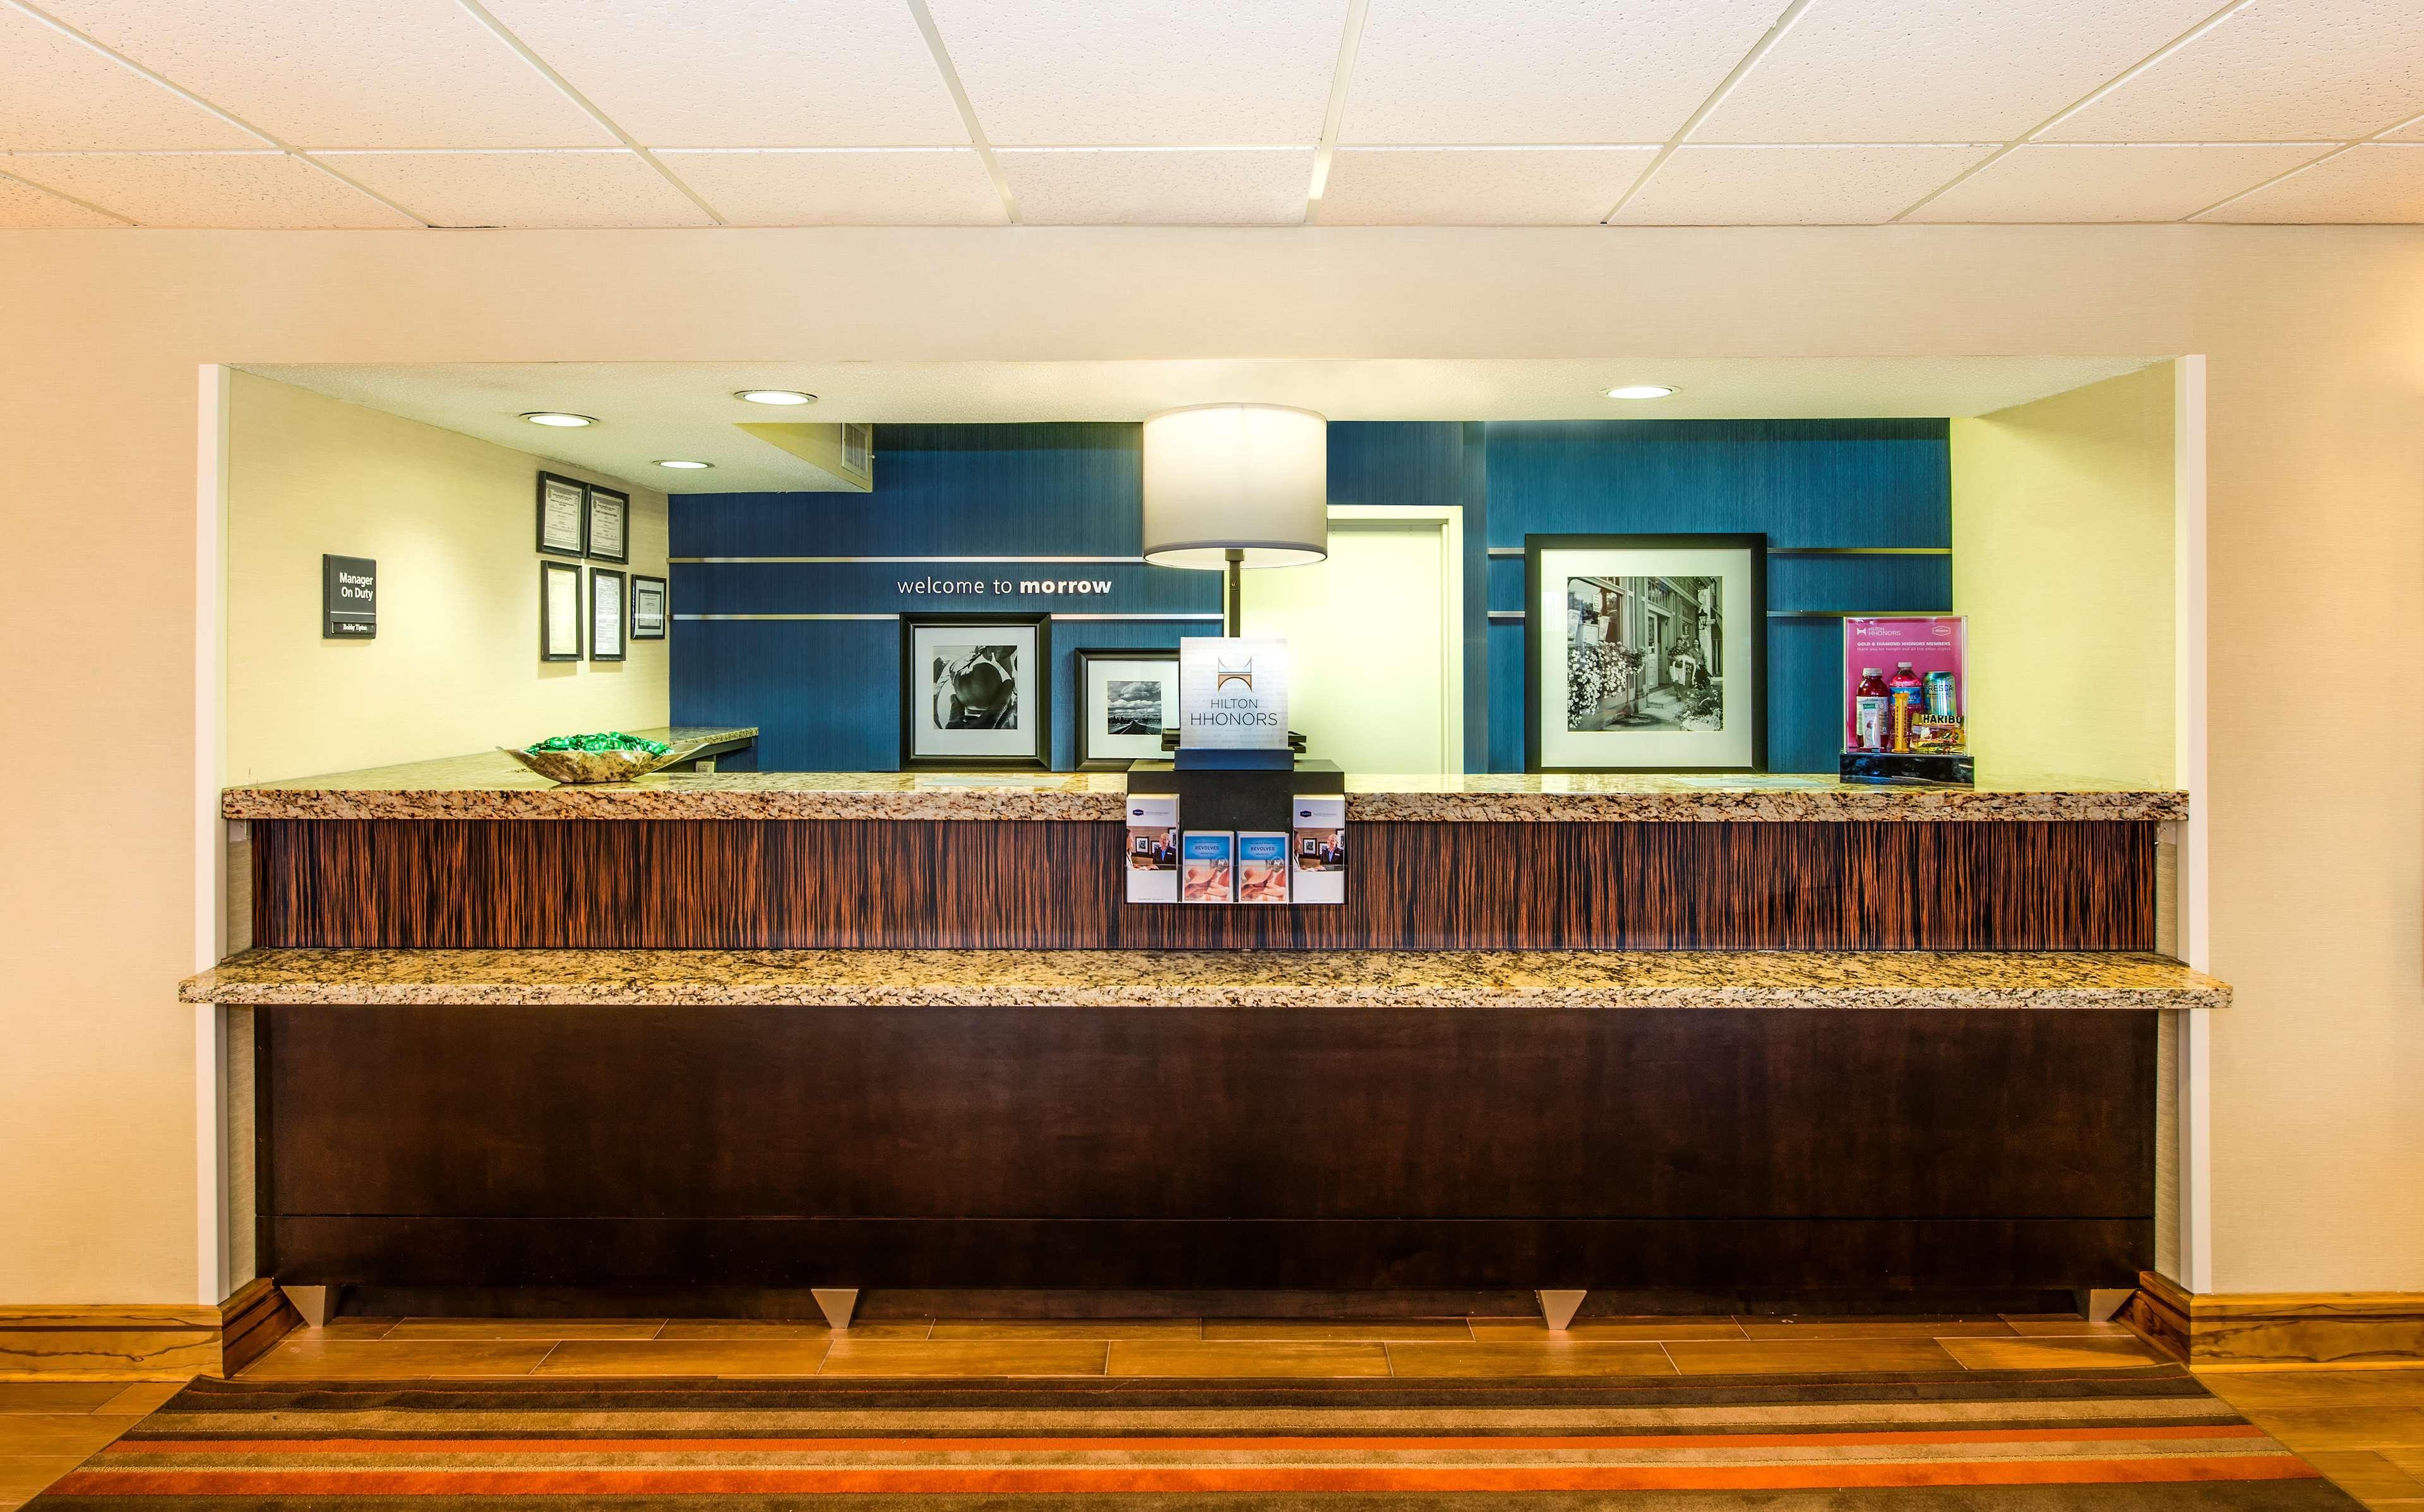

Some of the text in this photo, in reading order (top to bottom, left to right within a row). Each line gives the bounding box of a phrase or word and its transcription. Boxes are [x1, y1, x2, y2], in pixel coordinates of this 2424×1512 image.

[340, 572, 373, 587] Manager
[897, 576, 1112, 594] welcome to morrow
[341, 586, 373, 601] On Duty
[1211, 698, 1258, 708] HILTON
[1191, 713, 1277, 726] HHONORS
